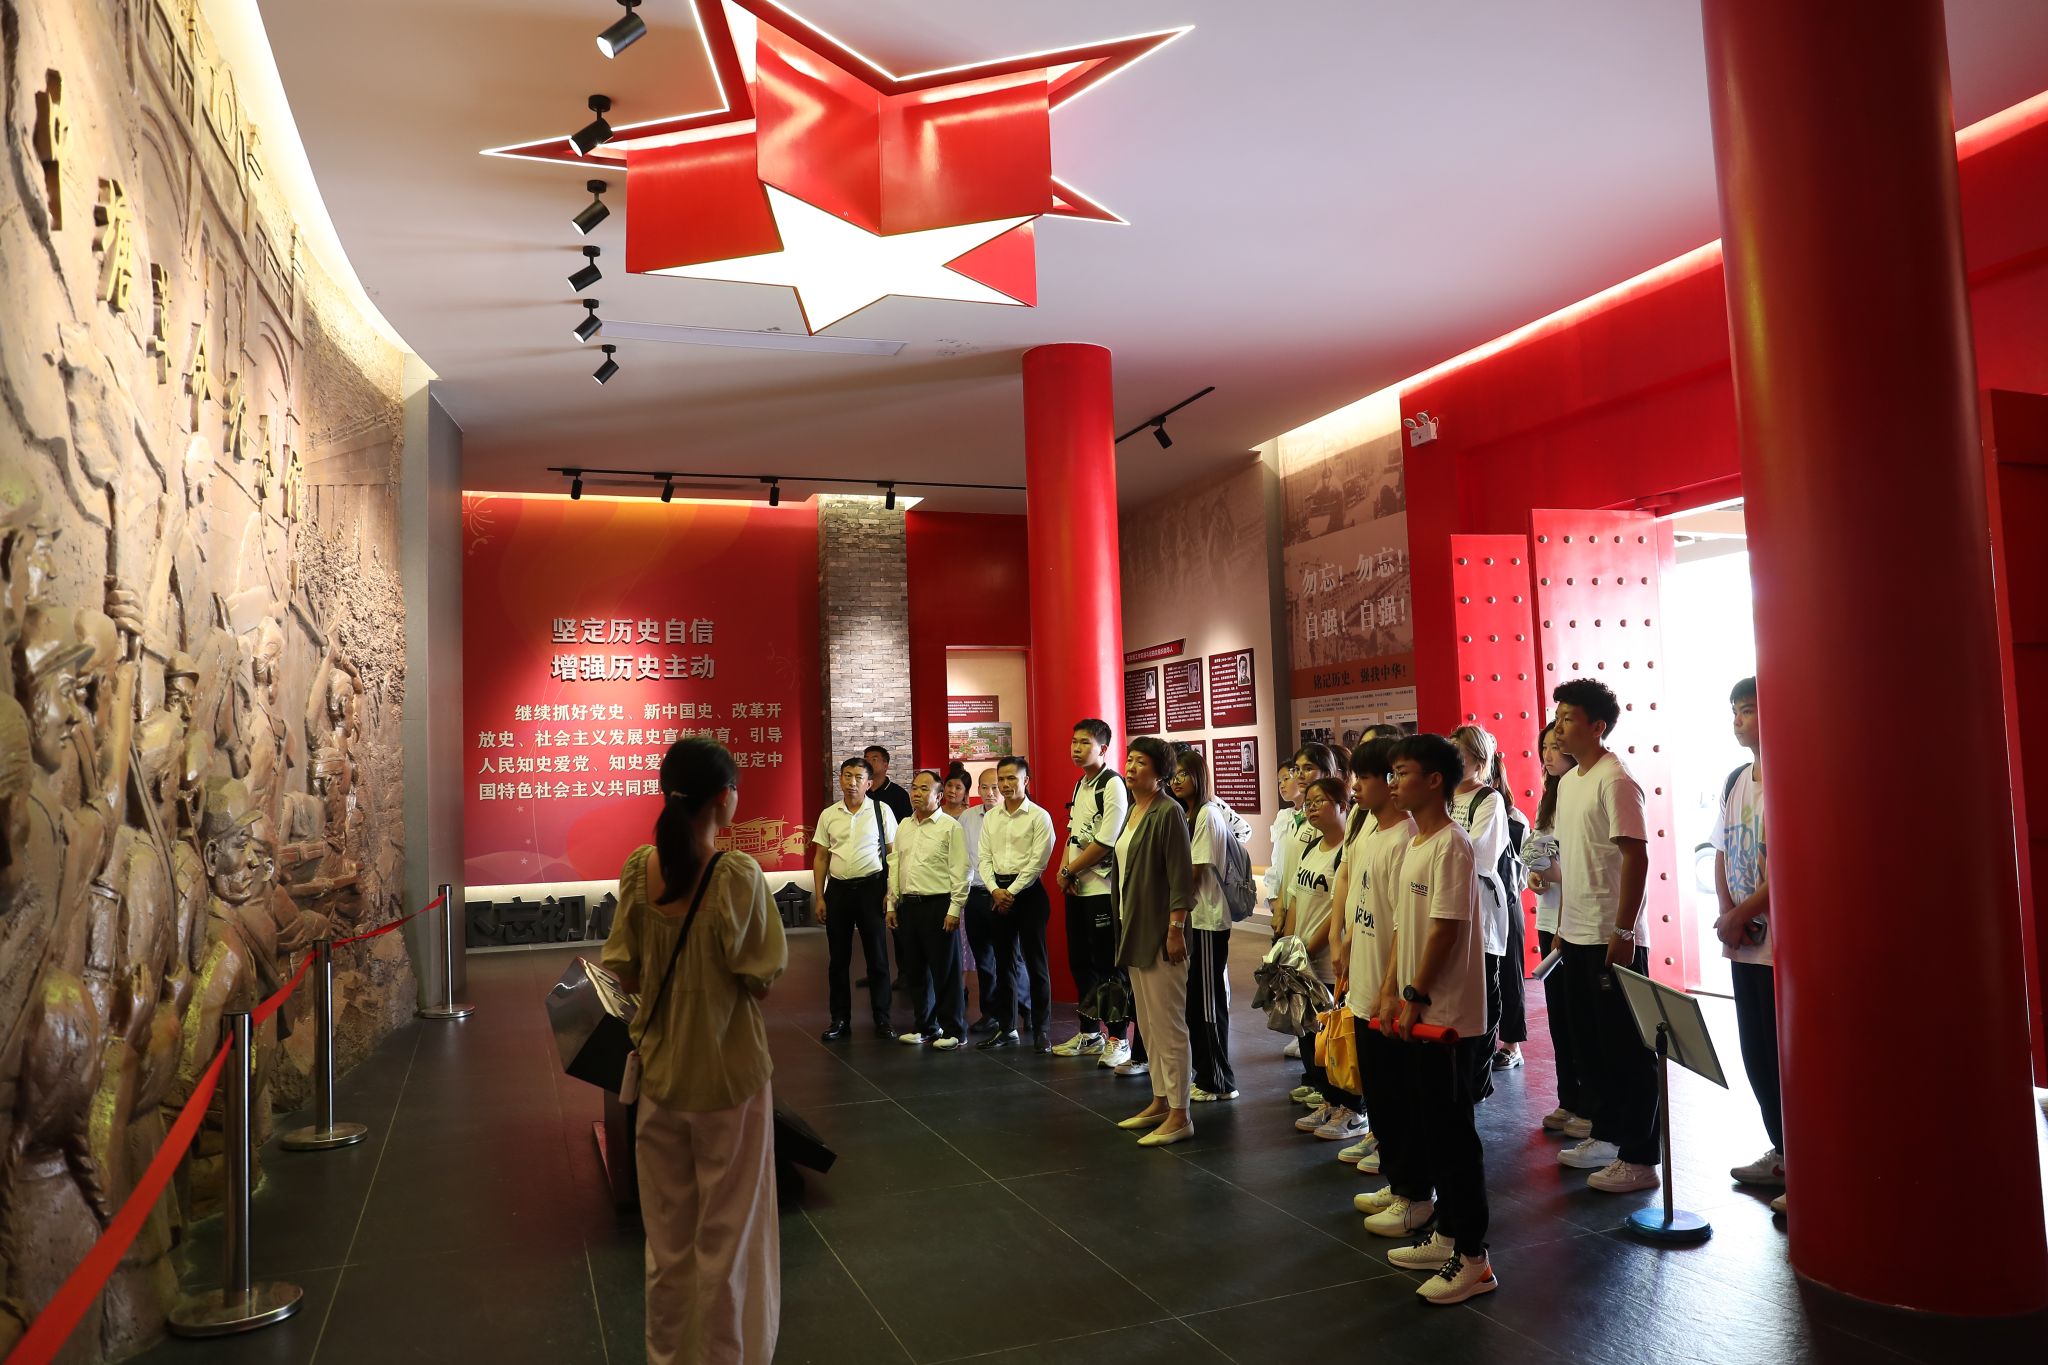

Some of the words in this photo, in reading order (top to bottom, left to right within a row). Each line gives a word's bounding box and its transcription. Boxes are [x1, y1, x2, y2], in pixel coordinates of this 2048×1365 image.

[552, 617, 715, 644] 坚定历史自信
[551, 654, 716, 681] 增强历史主动
[515, 702, 782, 722] 继续抓好党史、新中国史、改革开
[479, 779, 664, 801] 国特色社会主义共同理
[1296, 866, 1329, 893] HINA
